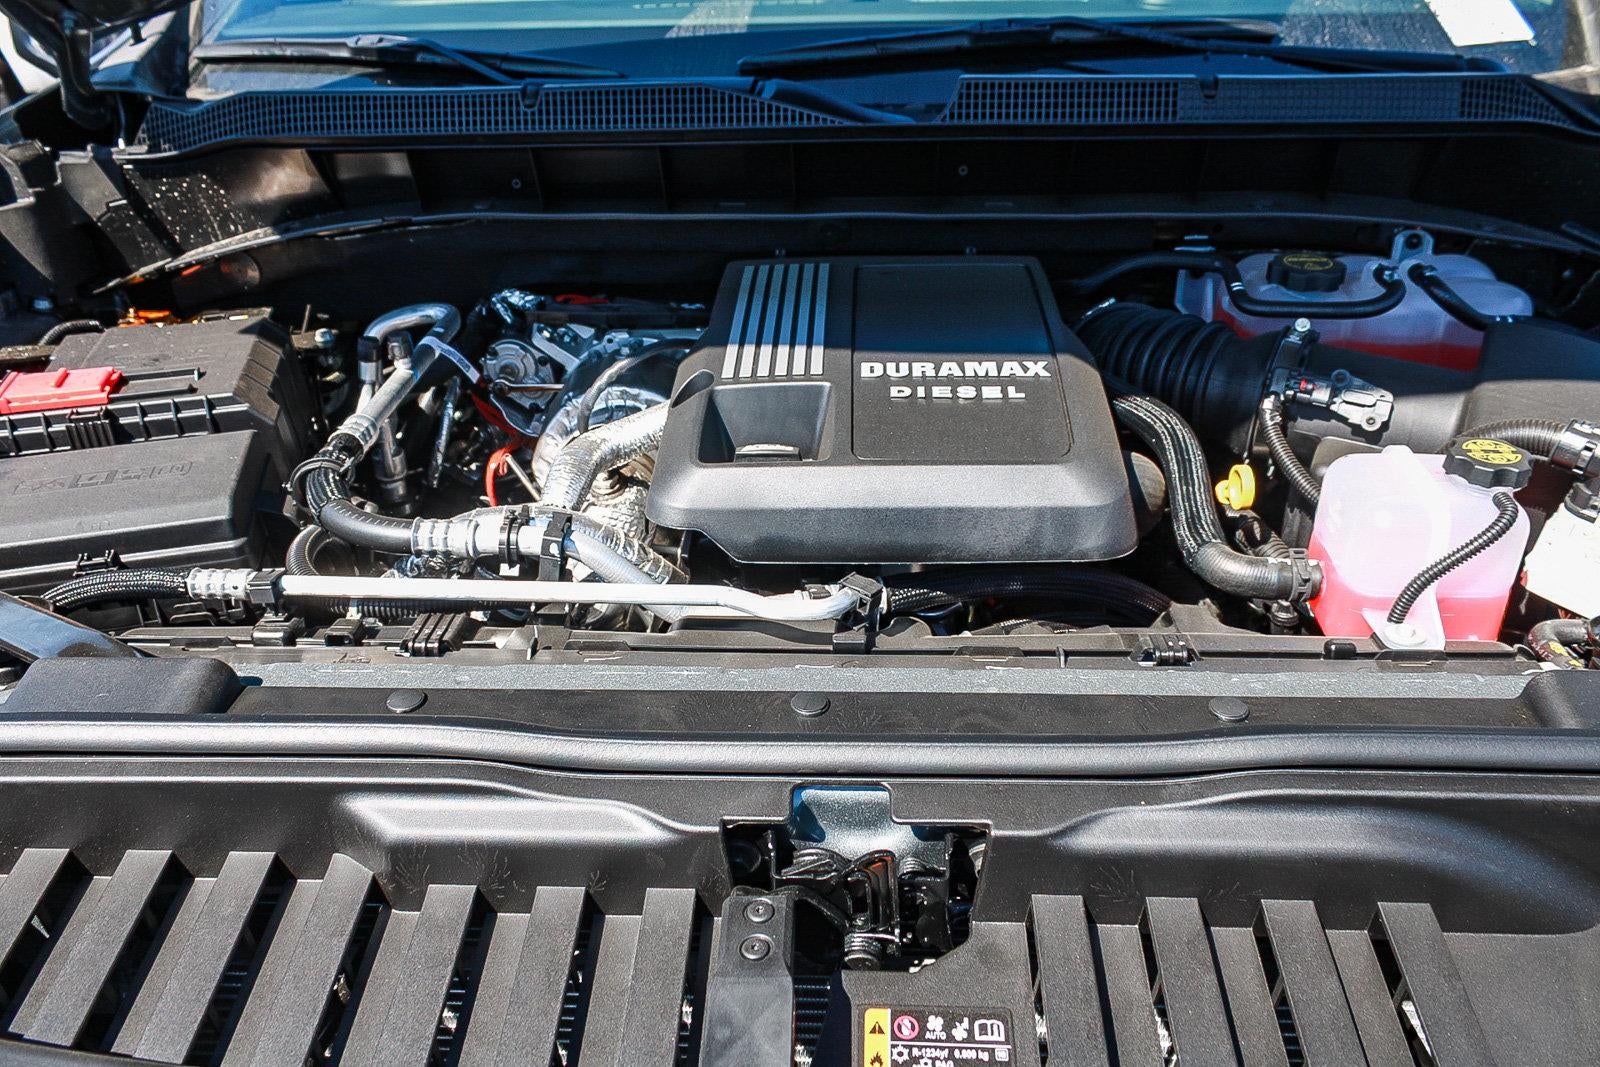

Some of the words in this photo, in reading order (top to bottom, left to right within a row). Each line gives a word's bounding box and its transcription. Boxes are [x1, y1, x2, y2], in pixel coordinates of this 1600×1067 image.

[860, 361, 1052, 377] DURAMAX
[889, 385, 1026, 399] DIESEL
[925, 1031, 946, 1040] AUTO
